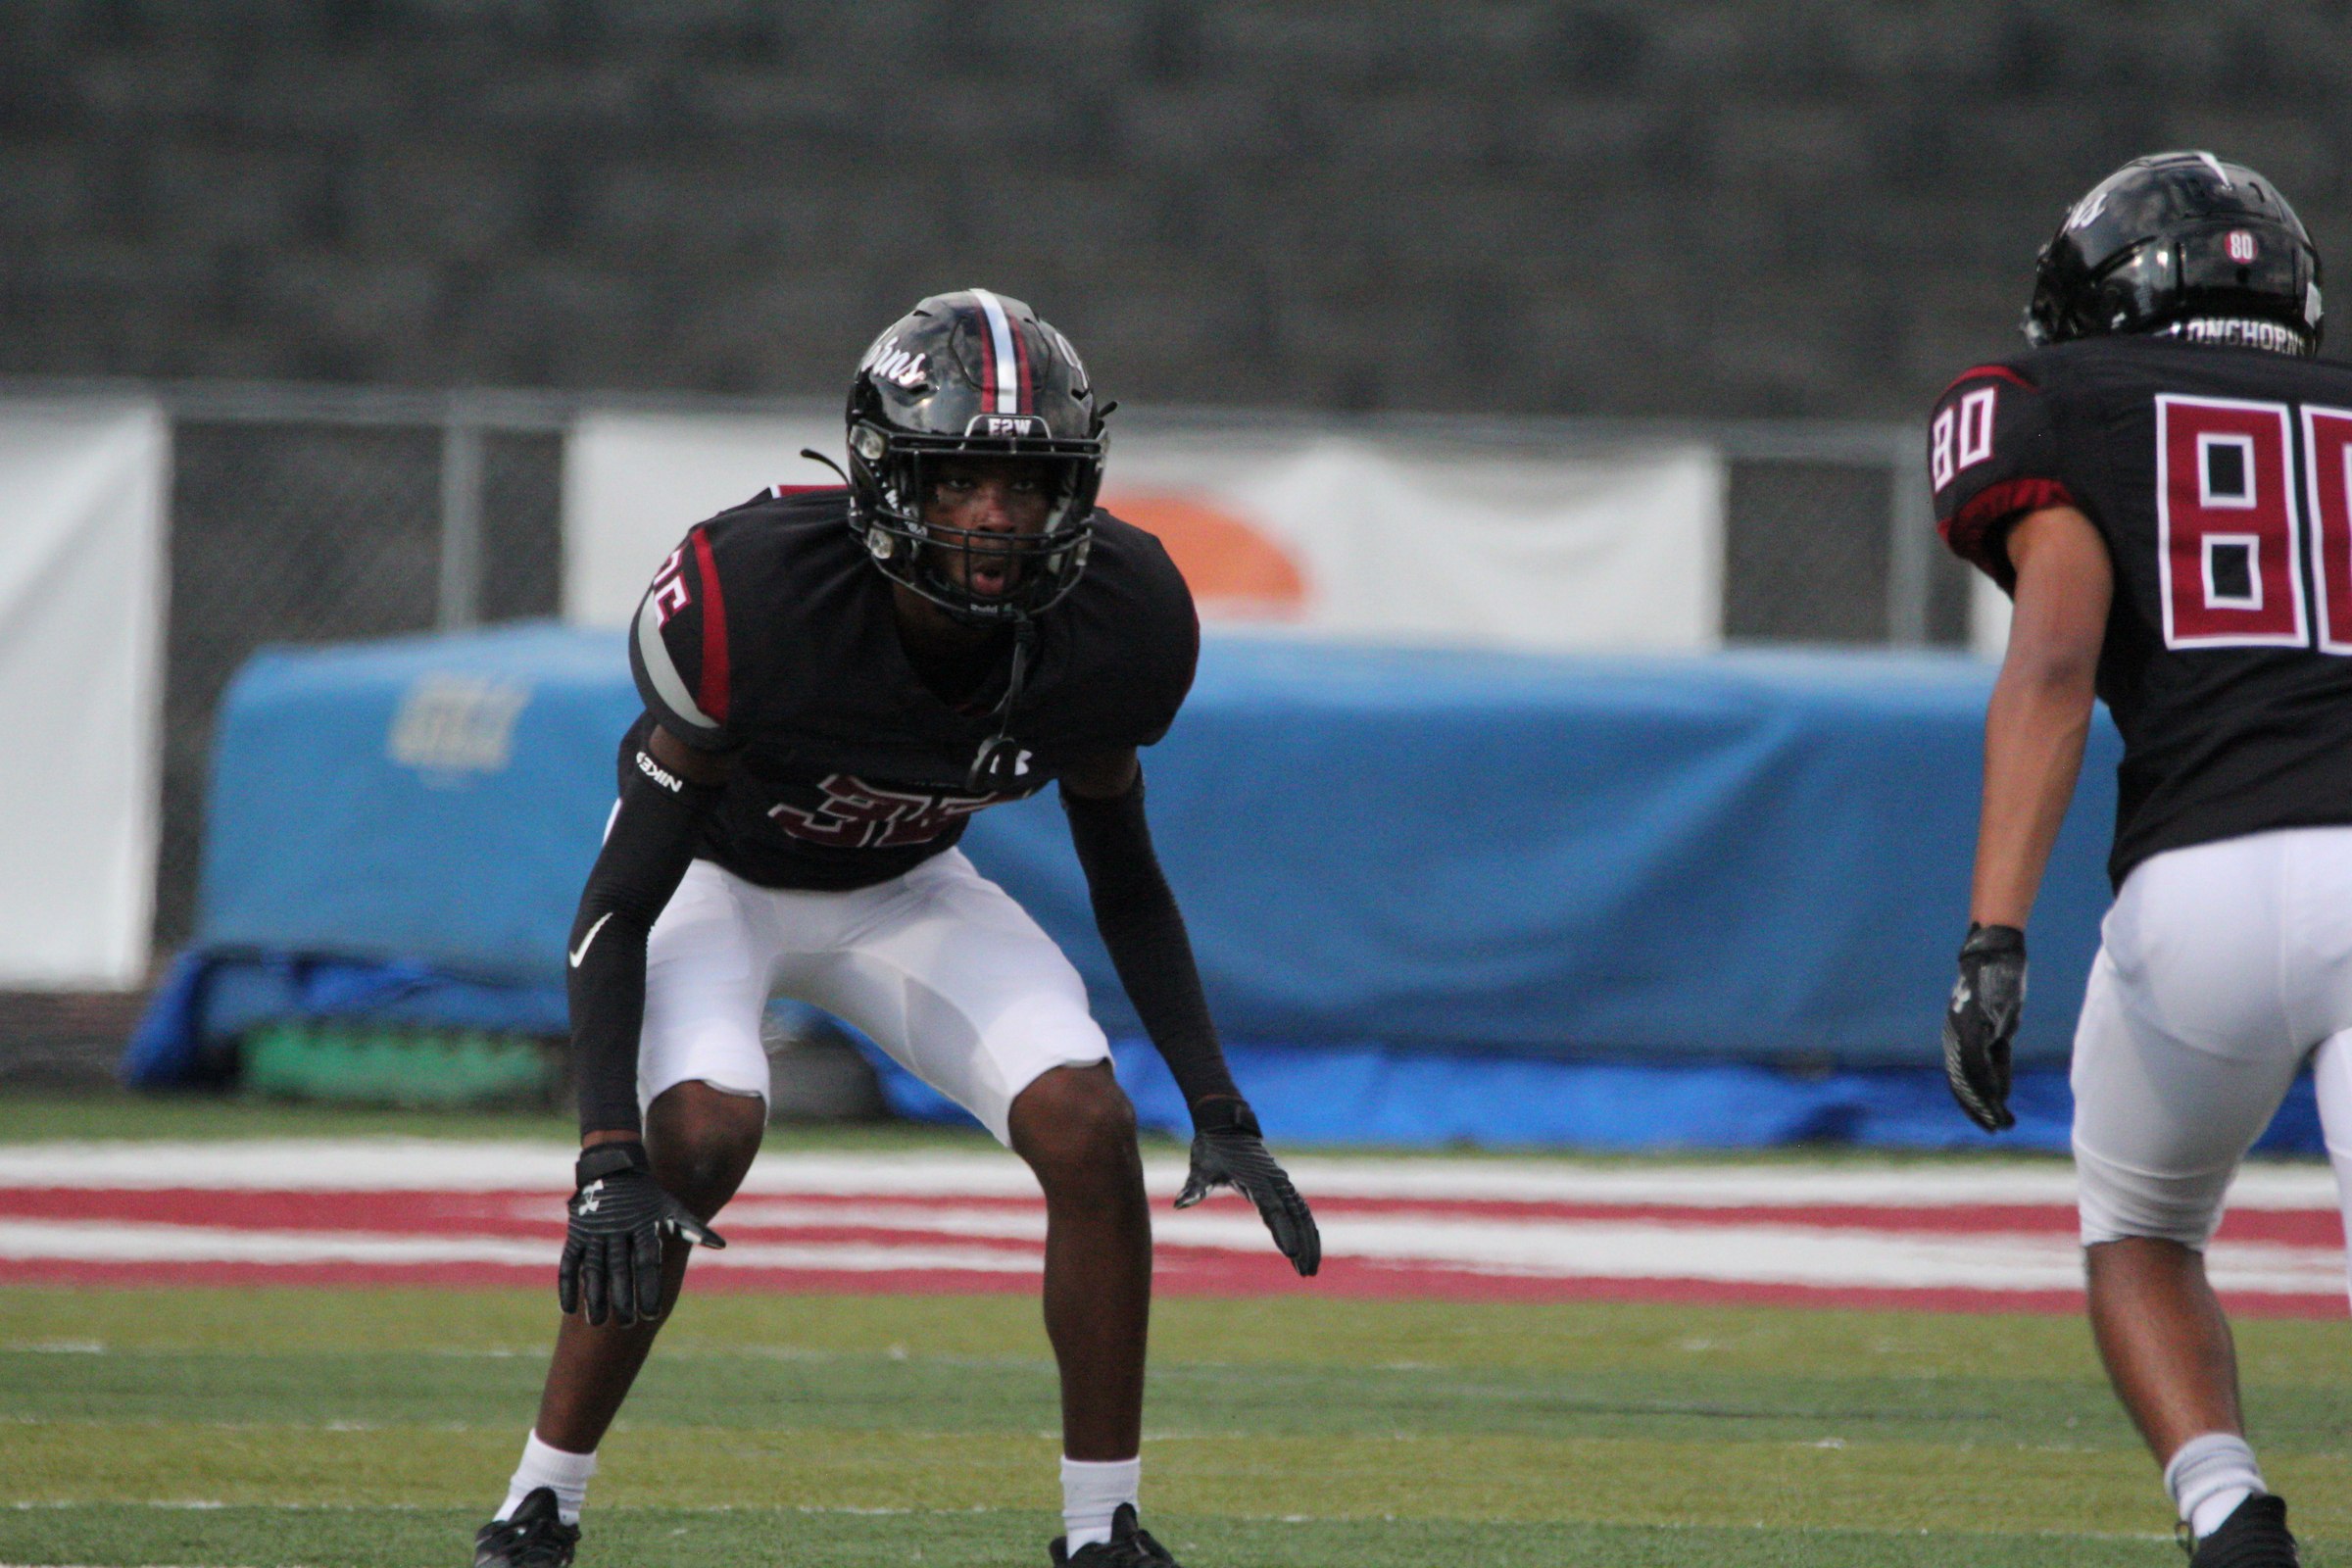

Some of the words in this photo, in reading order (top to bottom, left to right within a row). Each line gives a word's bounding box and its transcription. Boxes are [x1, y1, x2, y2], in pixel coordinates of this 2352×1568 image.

[2230, 231, 2253, 260] 80
[1931, 385, 1999, 494] 80
[638, 756, 683, 793] NIKE
